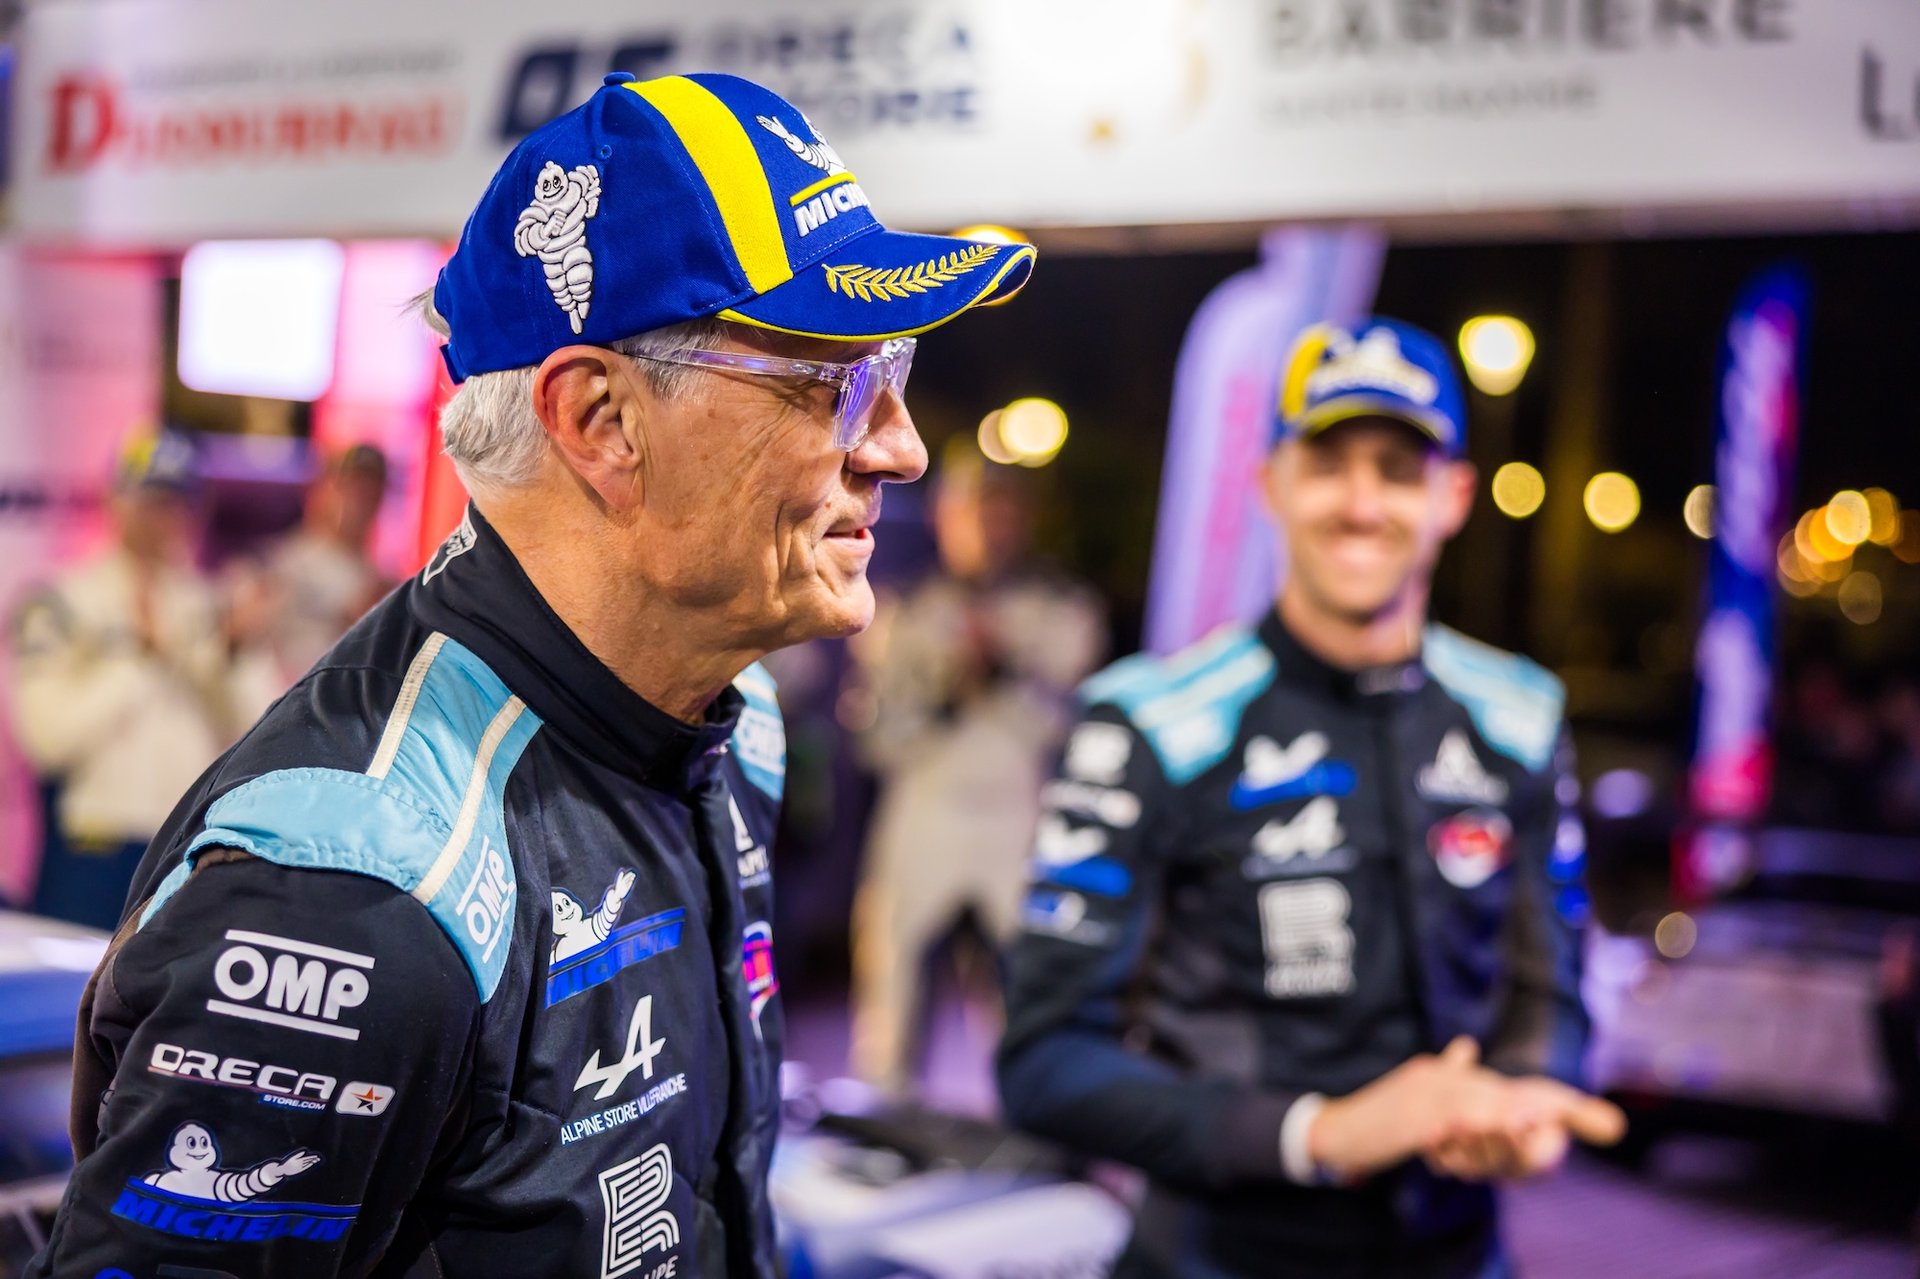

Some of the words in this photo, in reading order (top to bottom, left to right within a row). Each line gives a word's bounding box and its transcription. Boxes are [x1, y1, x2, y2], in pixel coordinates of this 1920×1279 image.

[1859, 42, 1920, 141] L
[467, 849, 509, 945] OMP
[214, 945, 370, 1021] OMP
[151, 1043, 337, 1100] ORECA
[263, 1094, 327, 1111] STORE.COM
[561, 1113, 605, 1145] ALPINE
[603, 1101, 639, 1129] STORE
[111, 1190, 350, 1242] MICHELIN
